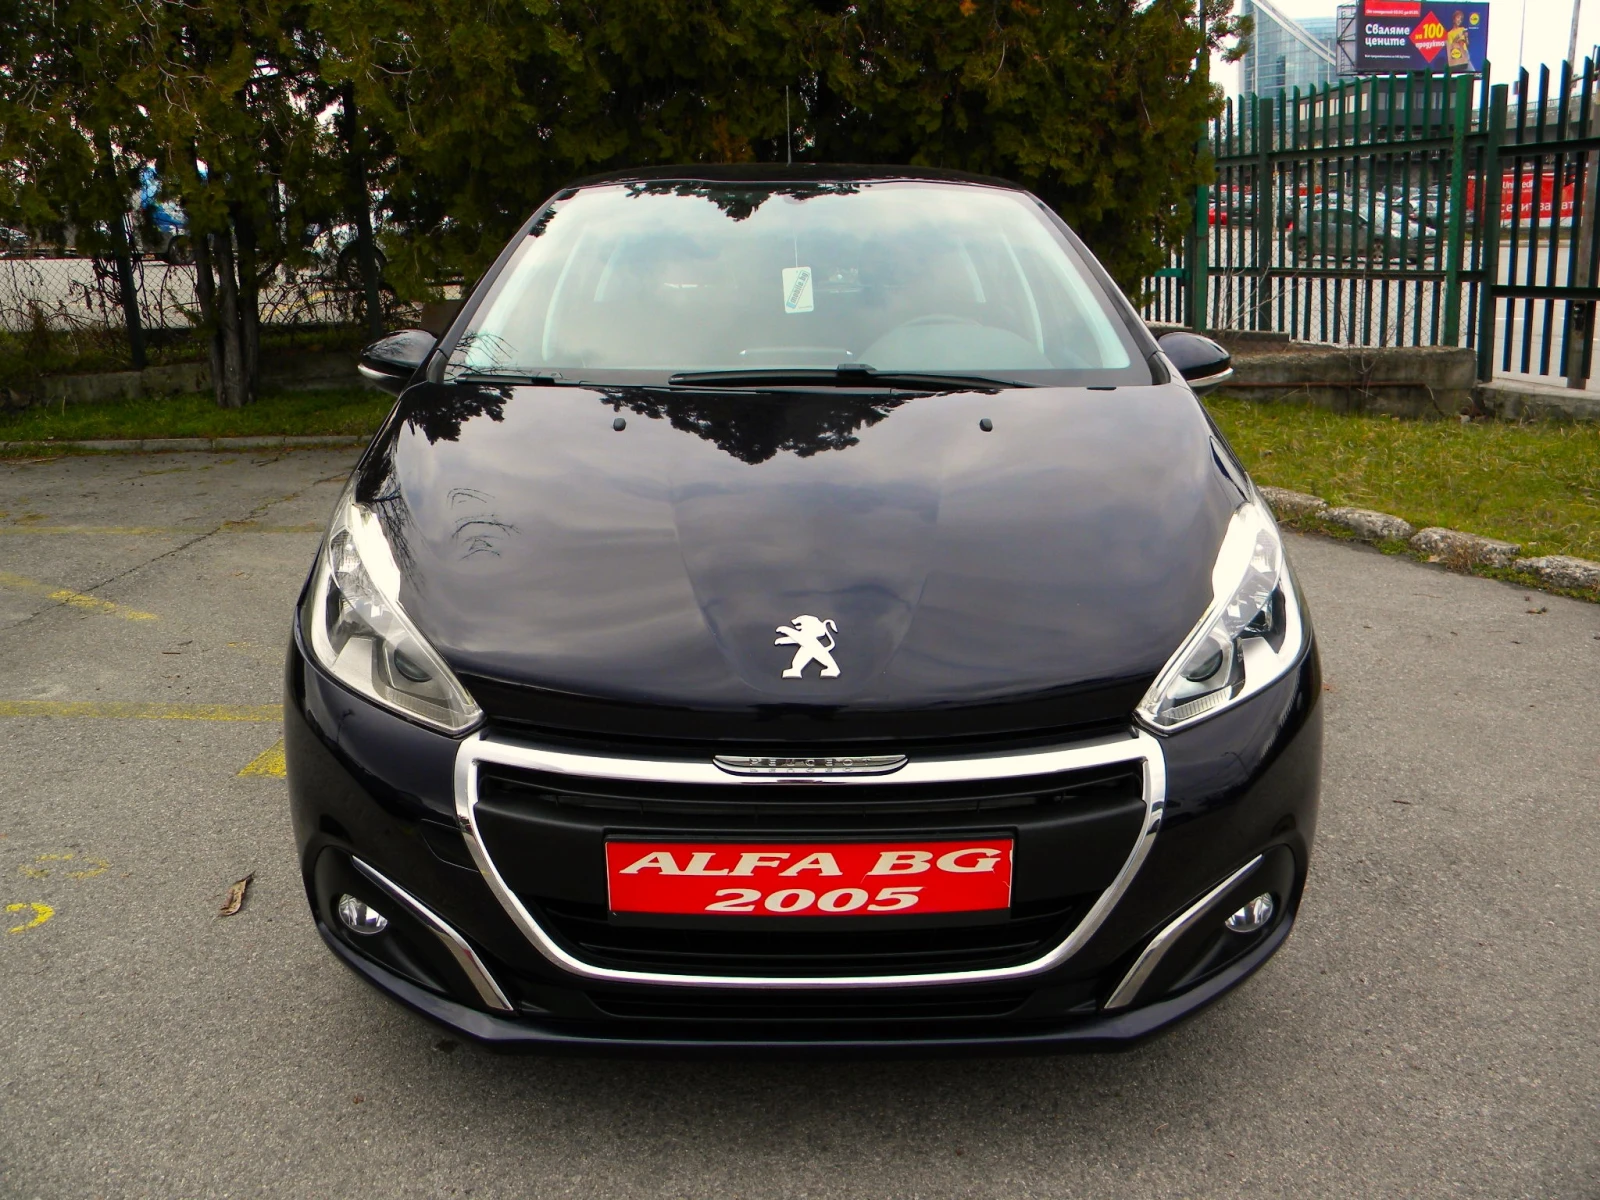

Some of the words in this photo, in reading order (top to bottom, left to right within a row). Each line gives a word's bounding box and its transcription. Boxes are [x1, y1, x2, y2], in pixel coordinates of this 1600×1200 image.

[1365, 23, 1410, 35] Сваляме
[1423, 23, 1444, 39] 100
[1365, 37, 1406, 47] цените
[619, 851, 843, 877] ALFA
[866, 848, 1002, 876] BG
[704, 886, 924, 912] 2005
